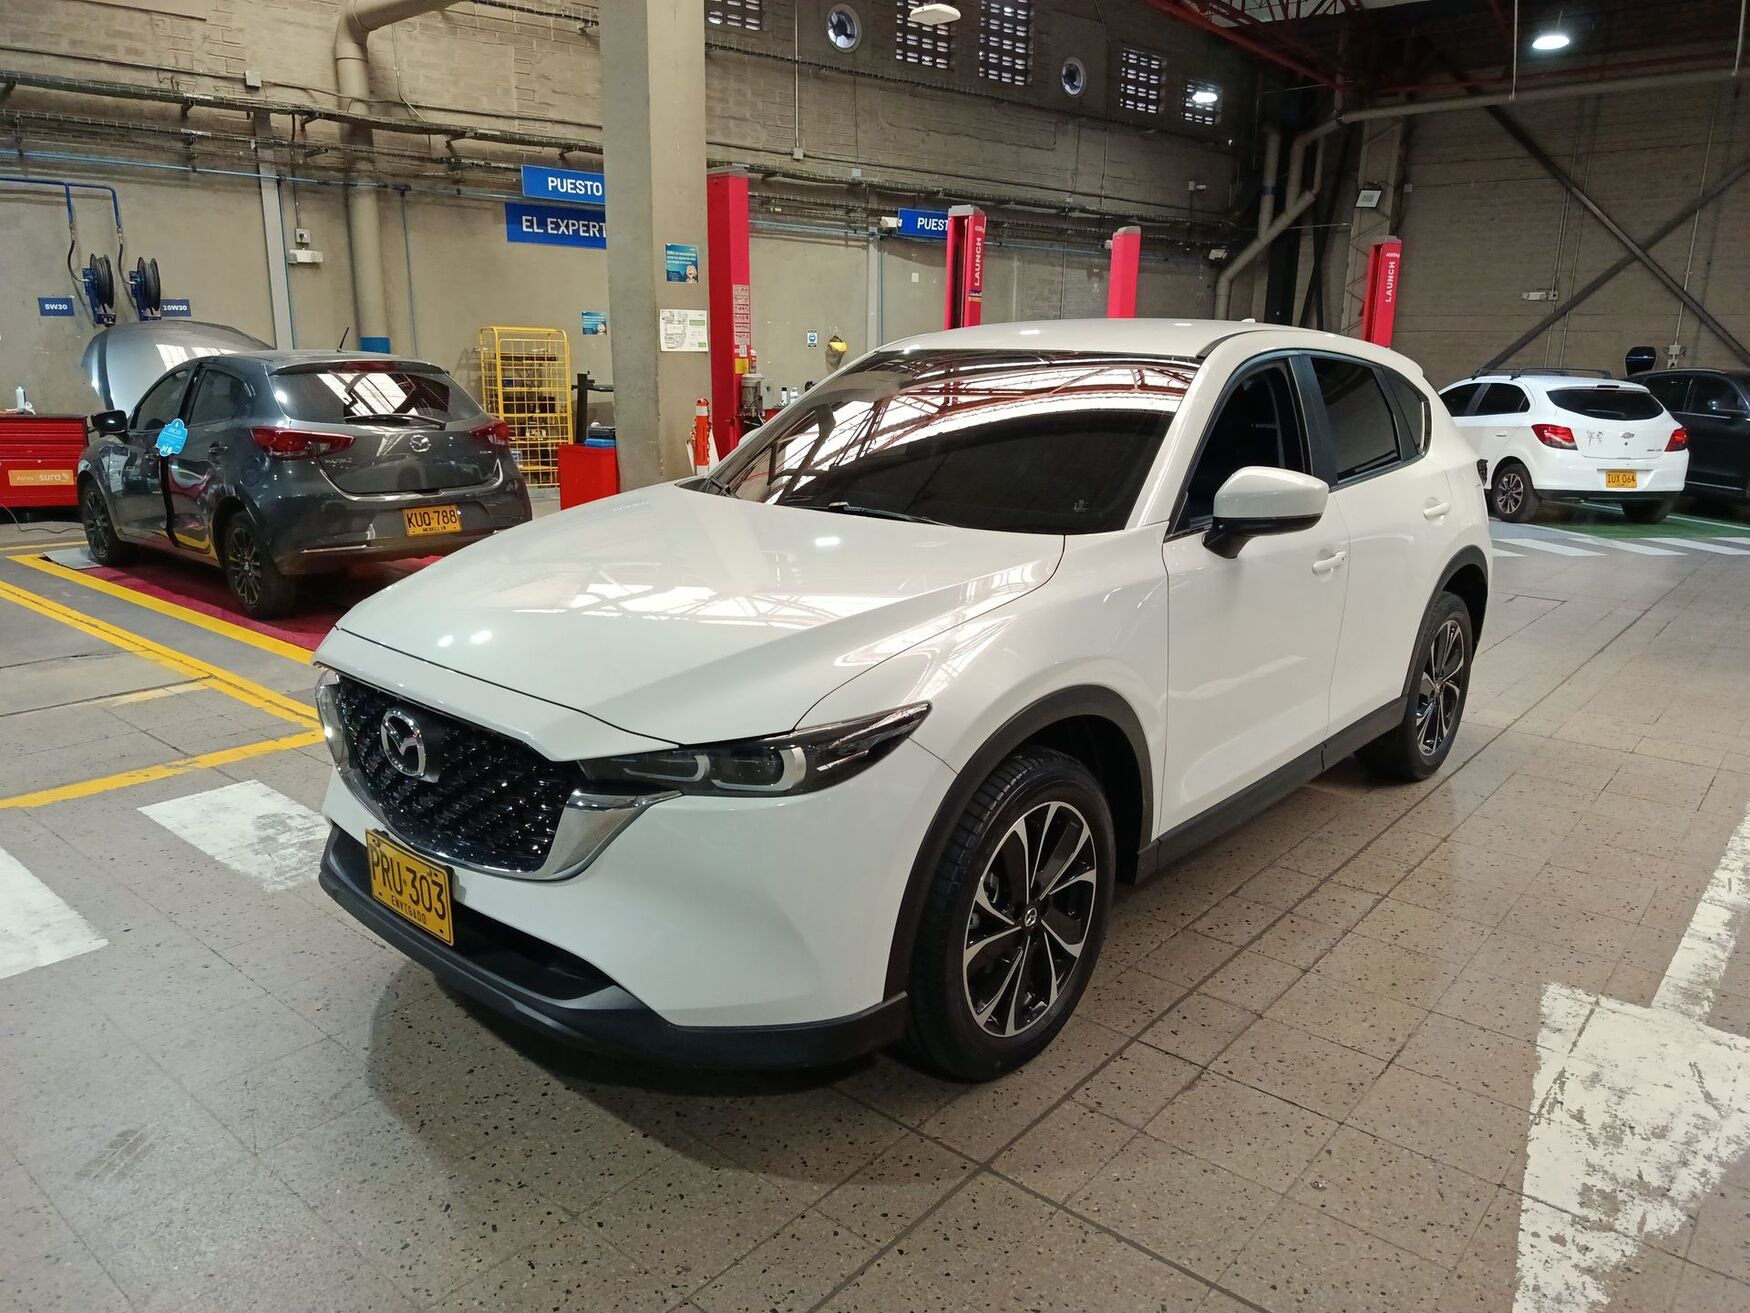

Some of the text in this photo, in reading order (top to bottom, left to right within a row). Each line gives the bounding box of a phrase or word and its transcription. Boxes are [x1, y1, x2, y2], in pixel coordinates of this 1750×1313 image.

[547, 176, 603, 196] PUESTO
[521, 215, 607, 238] EL EXPERT
[974, 237, 982, 287] LAUNCH
[1384, 261, 1396, 303] LAUNCH
